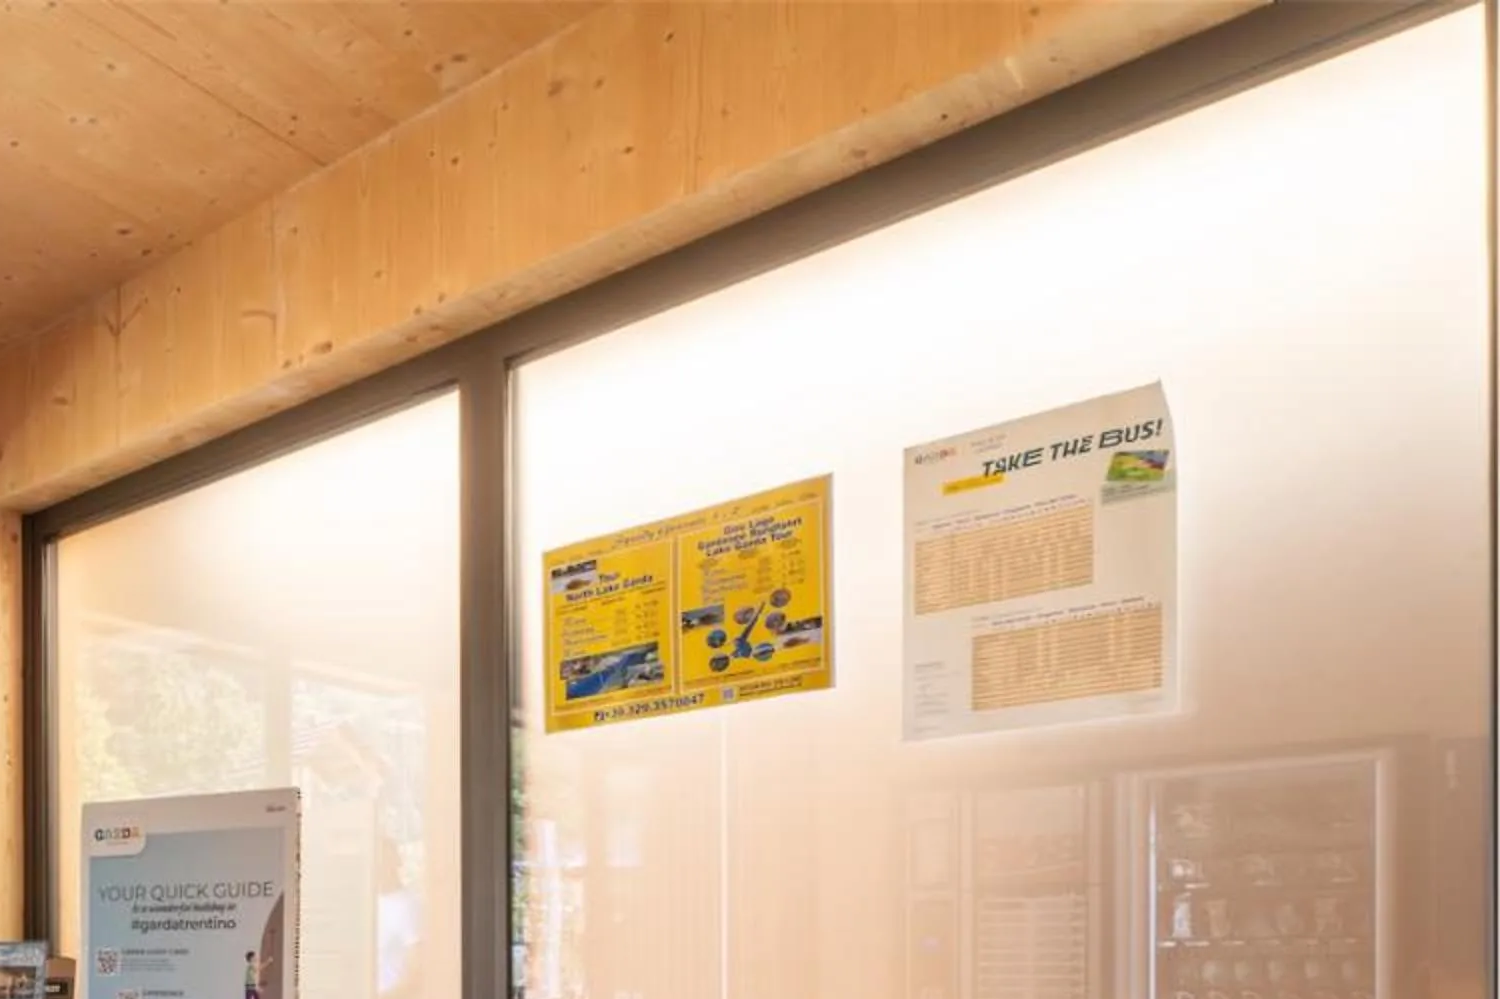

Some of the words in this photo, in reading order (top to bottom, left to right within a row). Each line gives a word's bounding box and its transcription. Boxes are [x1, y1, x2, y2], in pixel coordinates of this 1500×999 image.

[982, 447, 1045, 479] TAKE
[1050, 434, 1093, 461] THE
[1098, 417, 1164, 450] BUS!
[99, 884, 146, 902] YOUR
[150, 882, 210, 902] QUICK
[213, 880, 274, 899] GUIDE
[131, 916, 237, 934] #gardatrentino
